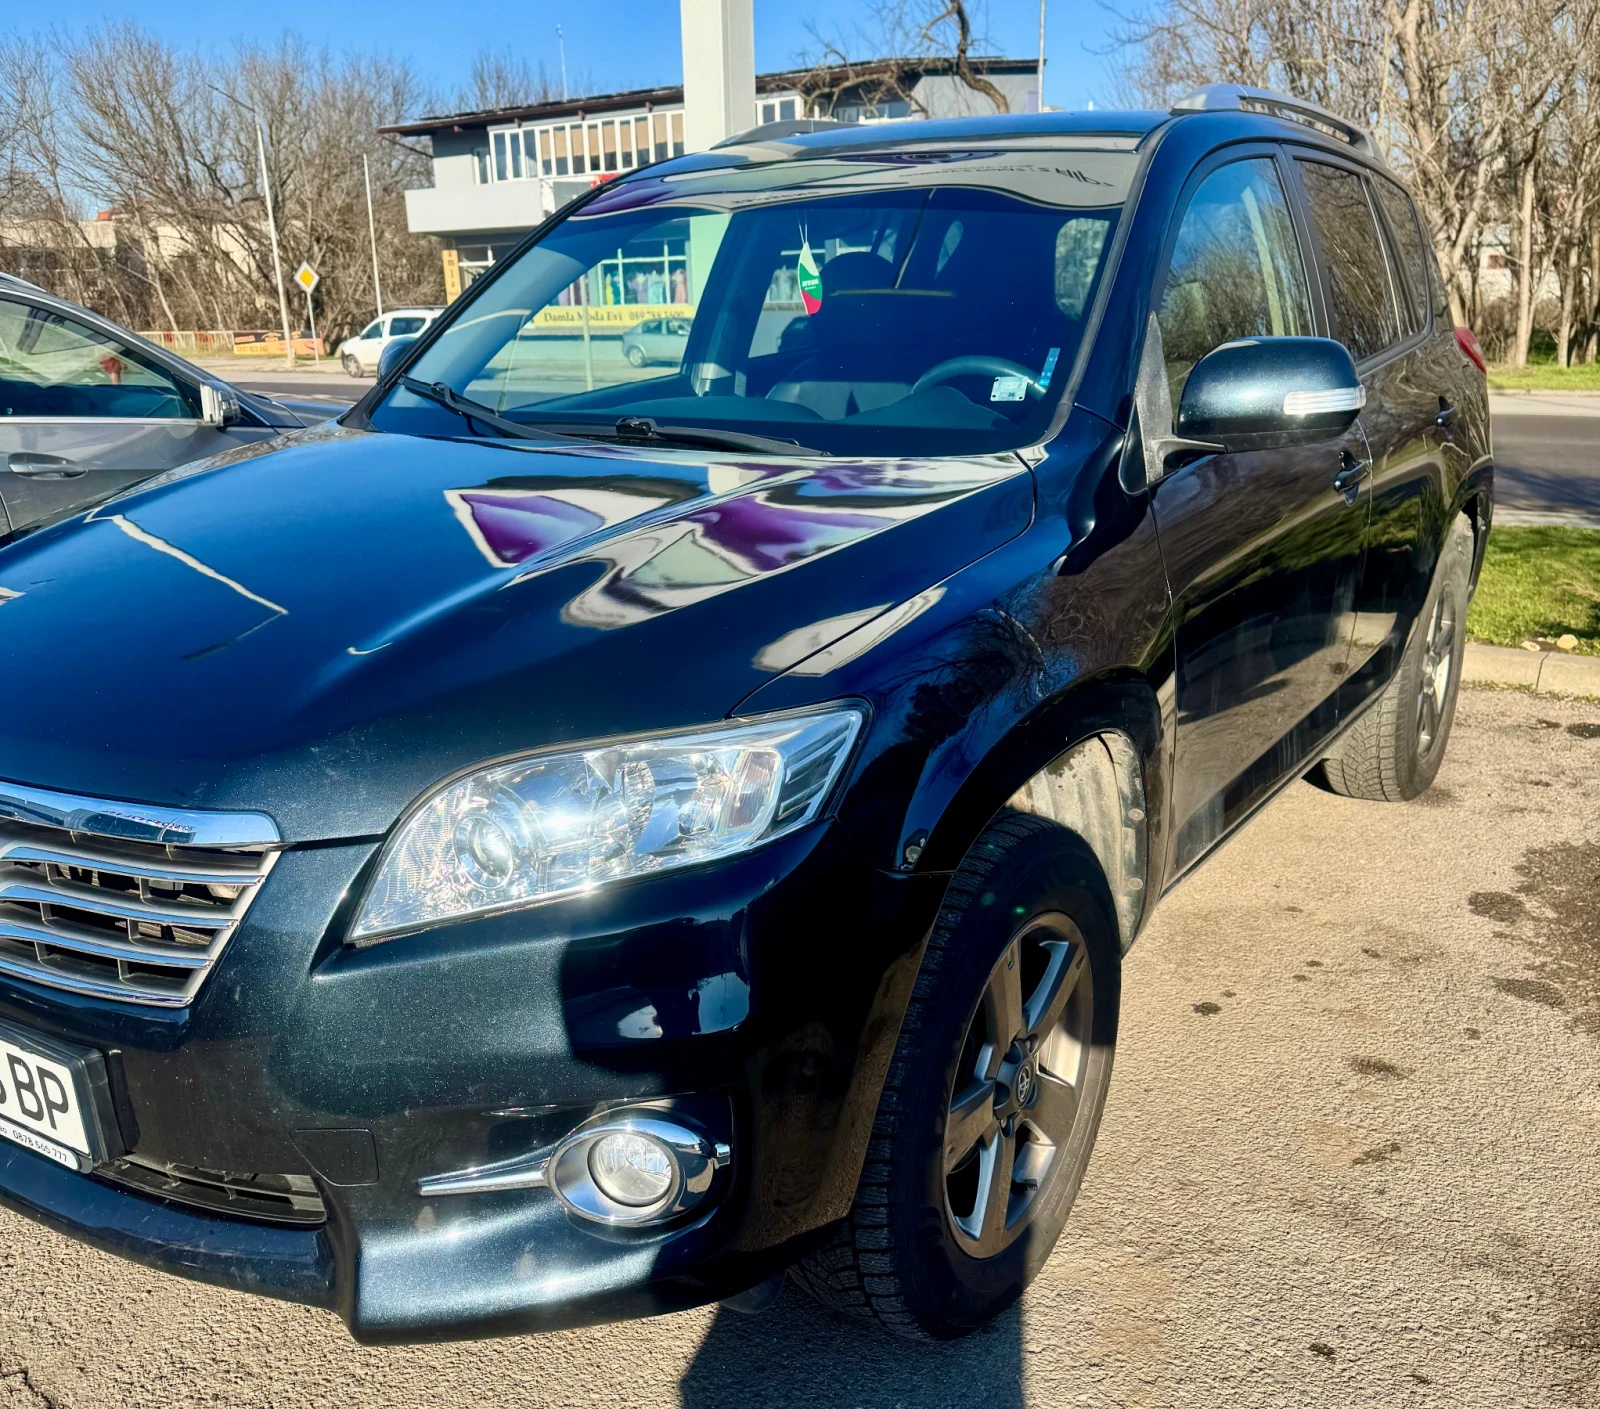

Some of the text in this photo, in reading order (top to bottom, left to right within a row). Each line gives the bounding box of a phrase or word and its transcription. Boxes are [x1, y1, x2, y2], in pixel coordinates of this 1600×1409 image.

[544, 312, 575, 322] Damla
[607, 311, 623, 321] Evi
[13, 1130, 67, 1162] 0878 565 777
